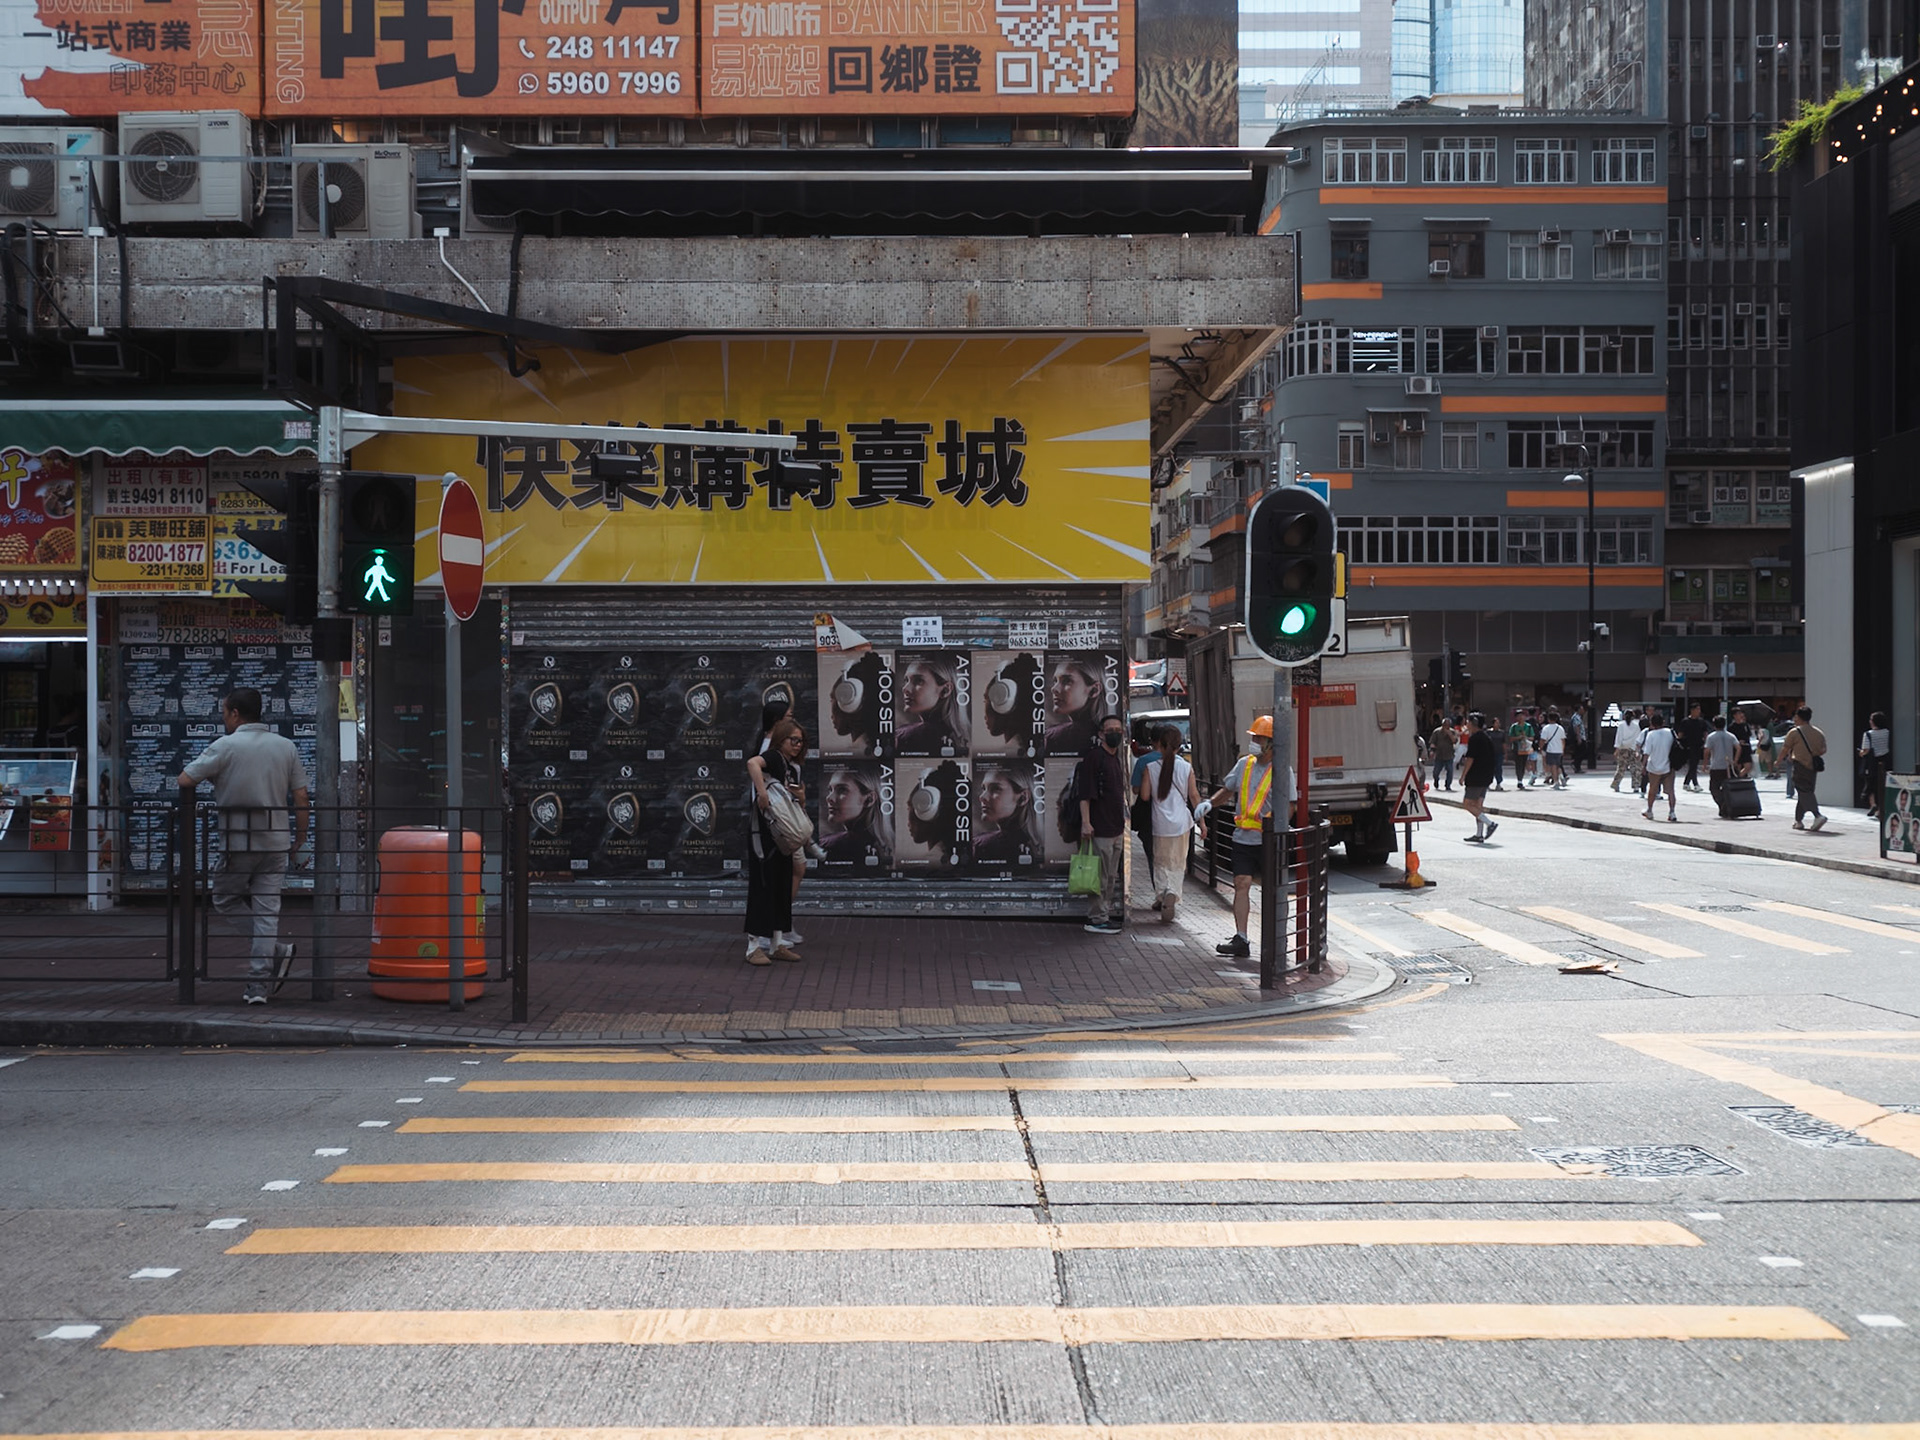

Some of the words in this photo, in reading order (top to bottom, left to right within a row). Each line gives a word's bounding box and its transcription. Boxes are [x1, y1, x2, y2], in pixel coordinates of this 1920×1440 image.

[540, 0, 599, 24] OUTPUT
[829, 0, 987, 35] BANNER
[23, 20, 190, 52] 一站式商業
[546, 36, 593, 59] 248
[602, 36, 680, 59] 11147
[109, 62, 247, 96] 印務中心
[546, 72, 610, 95] 5960
[618, 72, 681, 95] 7996
[711, 44, 820, 97] 易拉架
[828, 45, 981, 94] 回鄉證
[475, 417, 1029, 512] 快樂購特賣城
[132, 487, 164, 504] 9491
[169, 487, 204, 504] 8110
[128, 519, 206, 539] 美聯旺舖
[128, 543, 205, 563] 8200-1877
[146, 563, 205, 577] 2311-7368
[230, 562, 256, 574] For
[1009, 637, 1028, 648] 9683
[1029, 636, 1048, 647] 5434
[1059, 637, 1078, 648] 9683
[1327, 633, 1341, 652] 2
[877, 653, 893, 704] P100
[955, 654, 971, 707] A100
[1031, 653, 1045, 705] P100
[1104, 654, 1119, 707] A100
[877, 707, 893, 735] SE
[1031, 707, 1045, 735] SE
[879, 763, 894, 816] A100
[955, 762, 970, 813] P100
[1032, 763, 1045, 815] A100
[955, 815, 970, 842] SE
